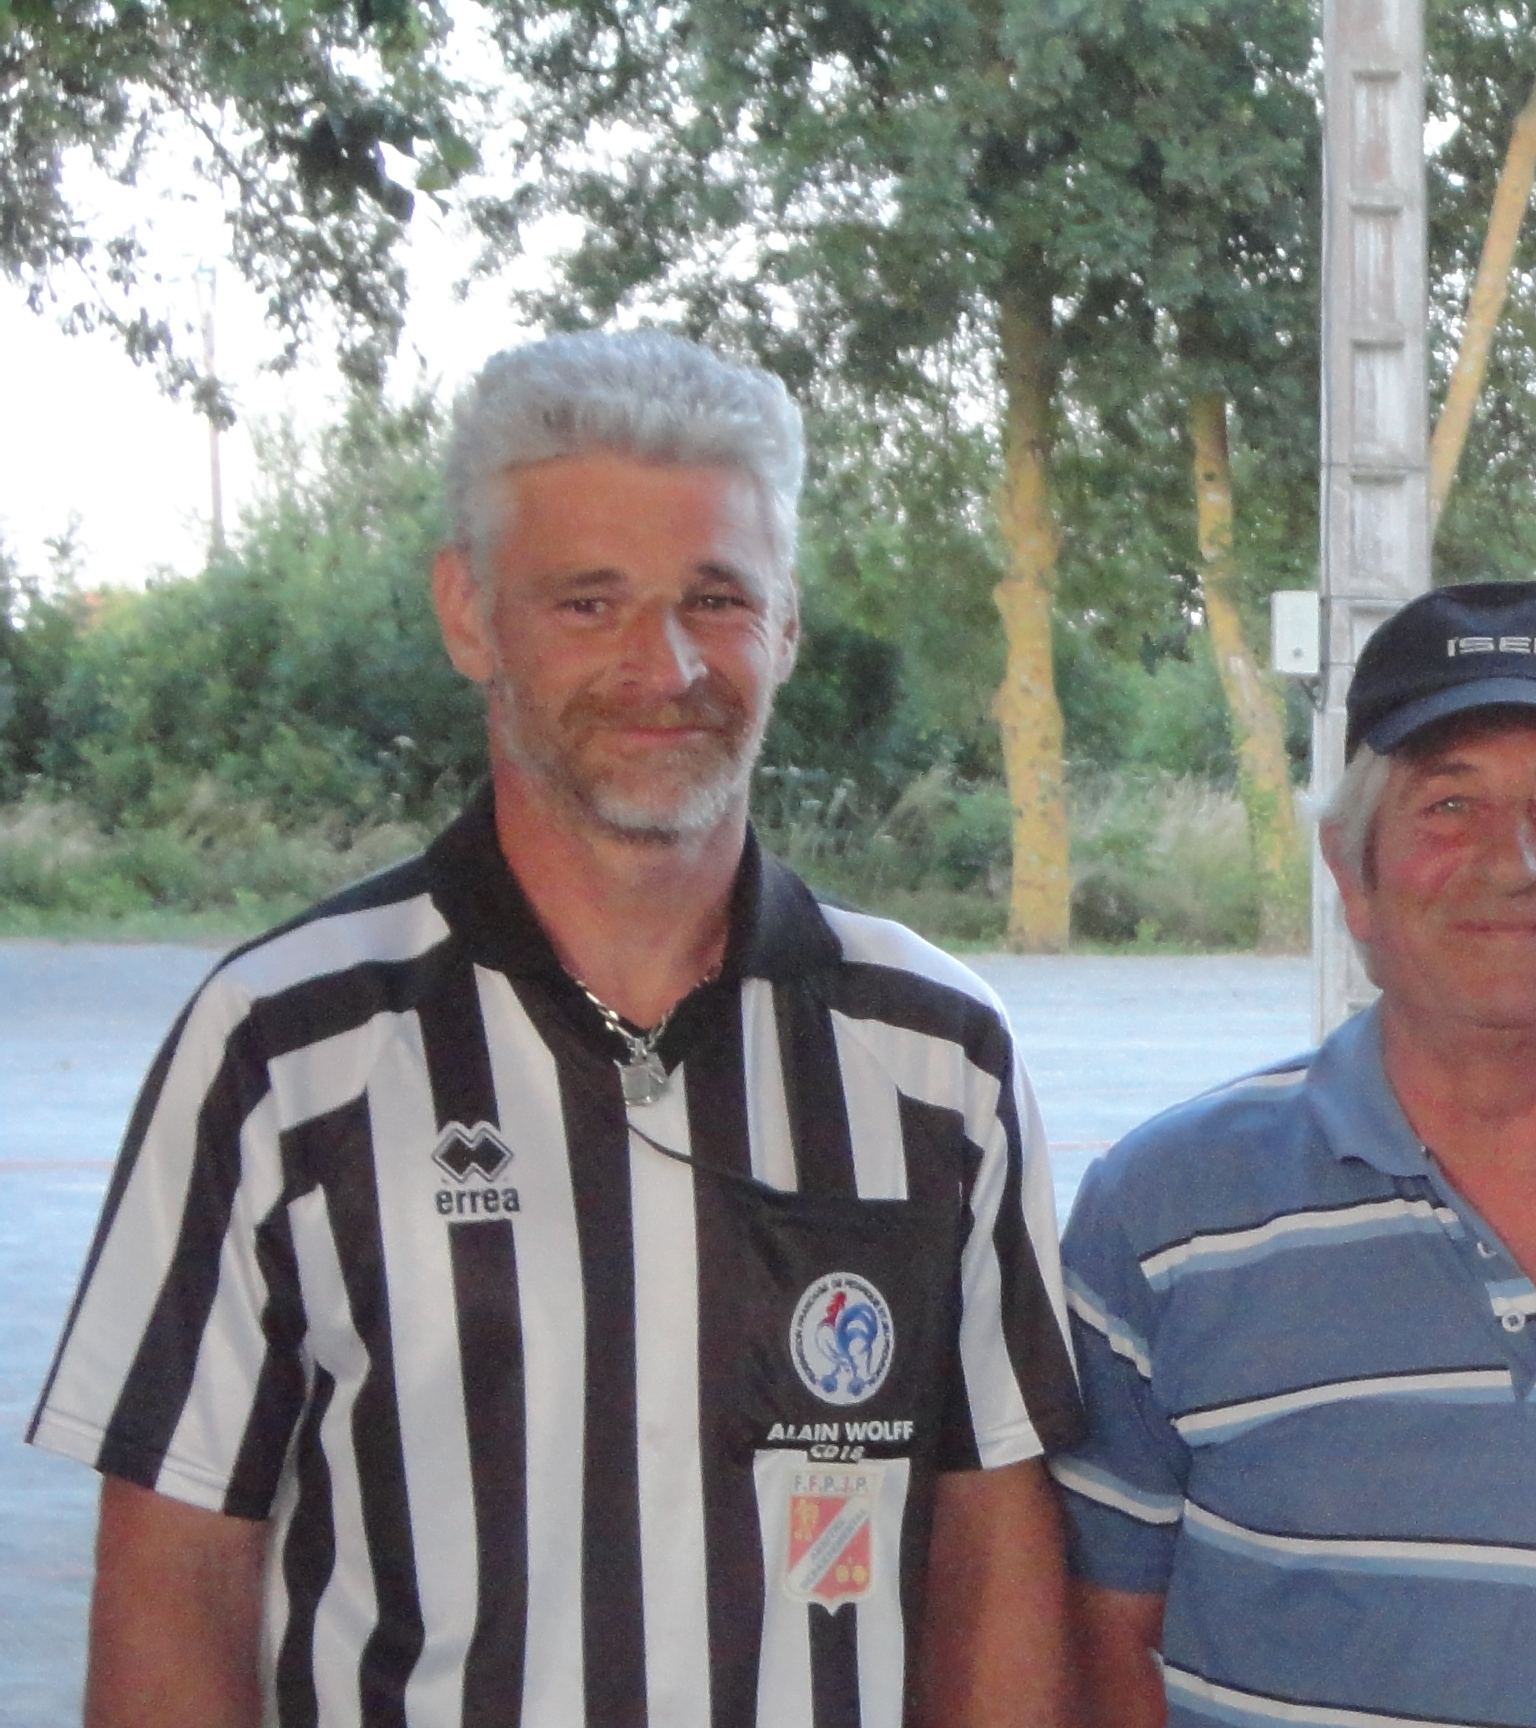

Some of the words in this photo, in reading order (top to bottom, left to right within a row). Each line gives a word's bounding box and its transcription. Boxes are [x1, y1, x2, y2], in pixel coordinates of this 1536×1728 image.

[434, 1186, 521, 1215] errea
[765, 1422, 840, 1441] ALAIN
[844, 1420, 915, 1442] WOLFF
